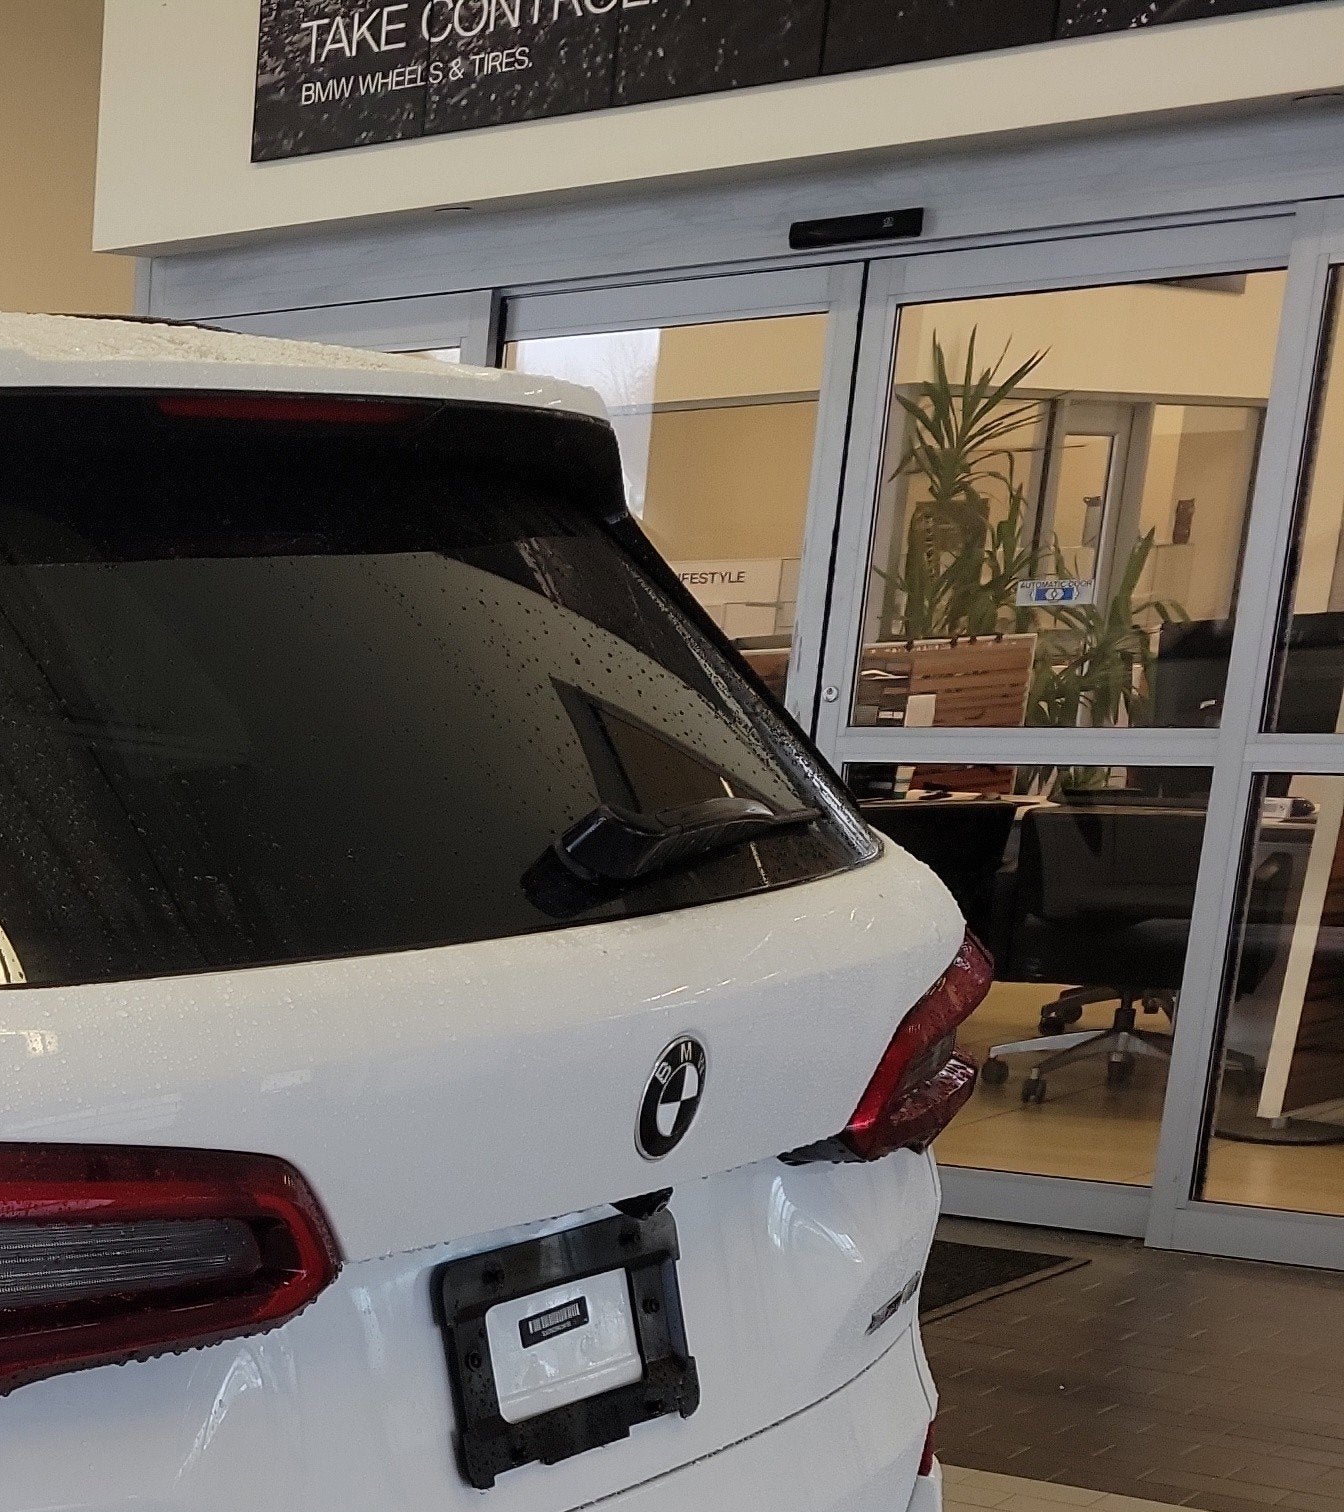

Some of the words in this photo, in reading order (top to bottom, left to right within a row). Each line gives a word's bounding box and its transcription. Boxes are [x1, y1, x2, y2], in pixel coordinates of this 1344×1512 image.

[300, 3, 409, 65] TAKE
[300, 75, 355, 106] BMW
[358, 61, 444, 96] WHEELS
[448, 58, 465, 81] &
[471, 47, 534, 77] TIRES.
[655, 1041, 706, 1086] BMW
